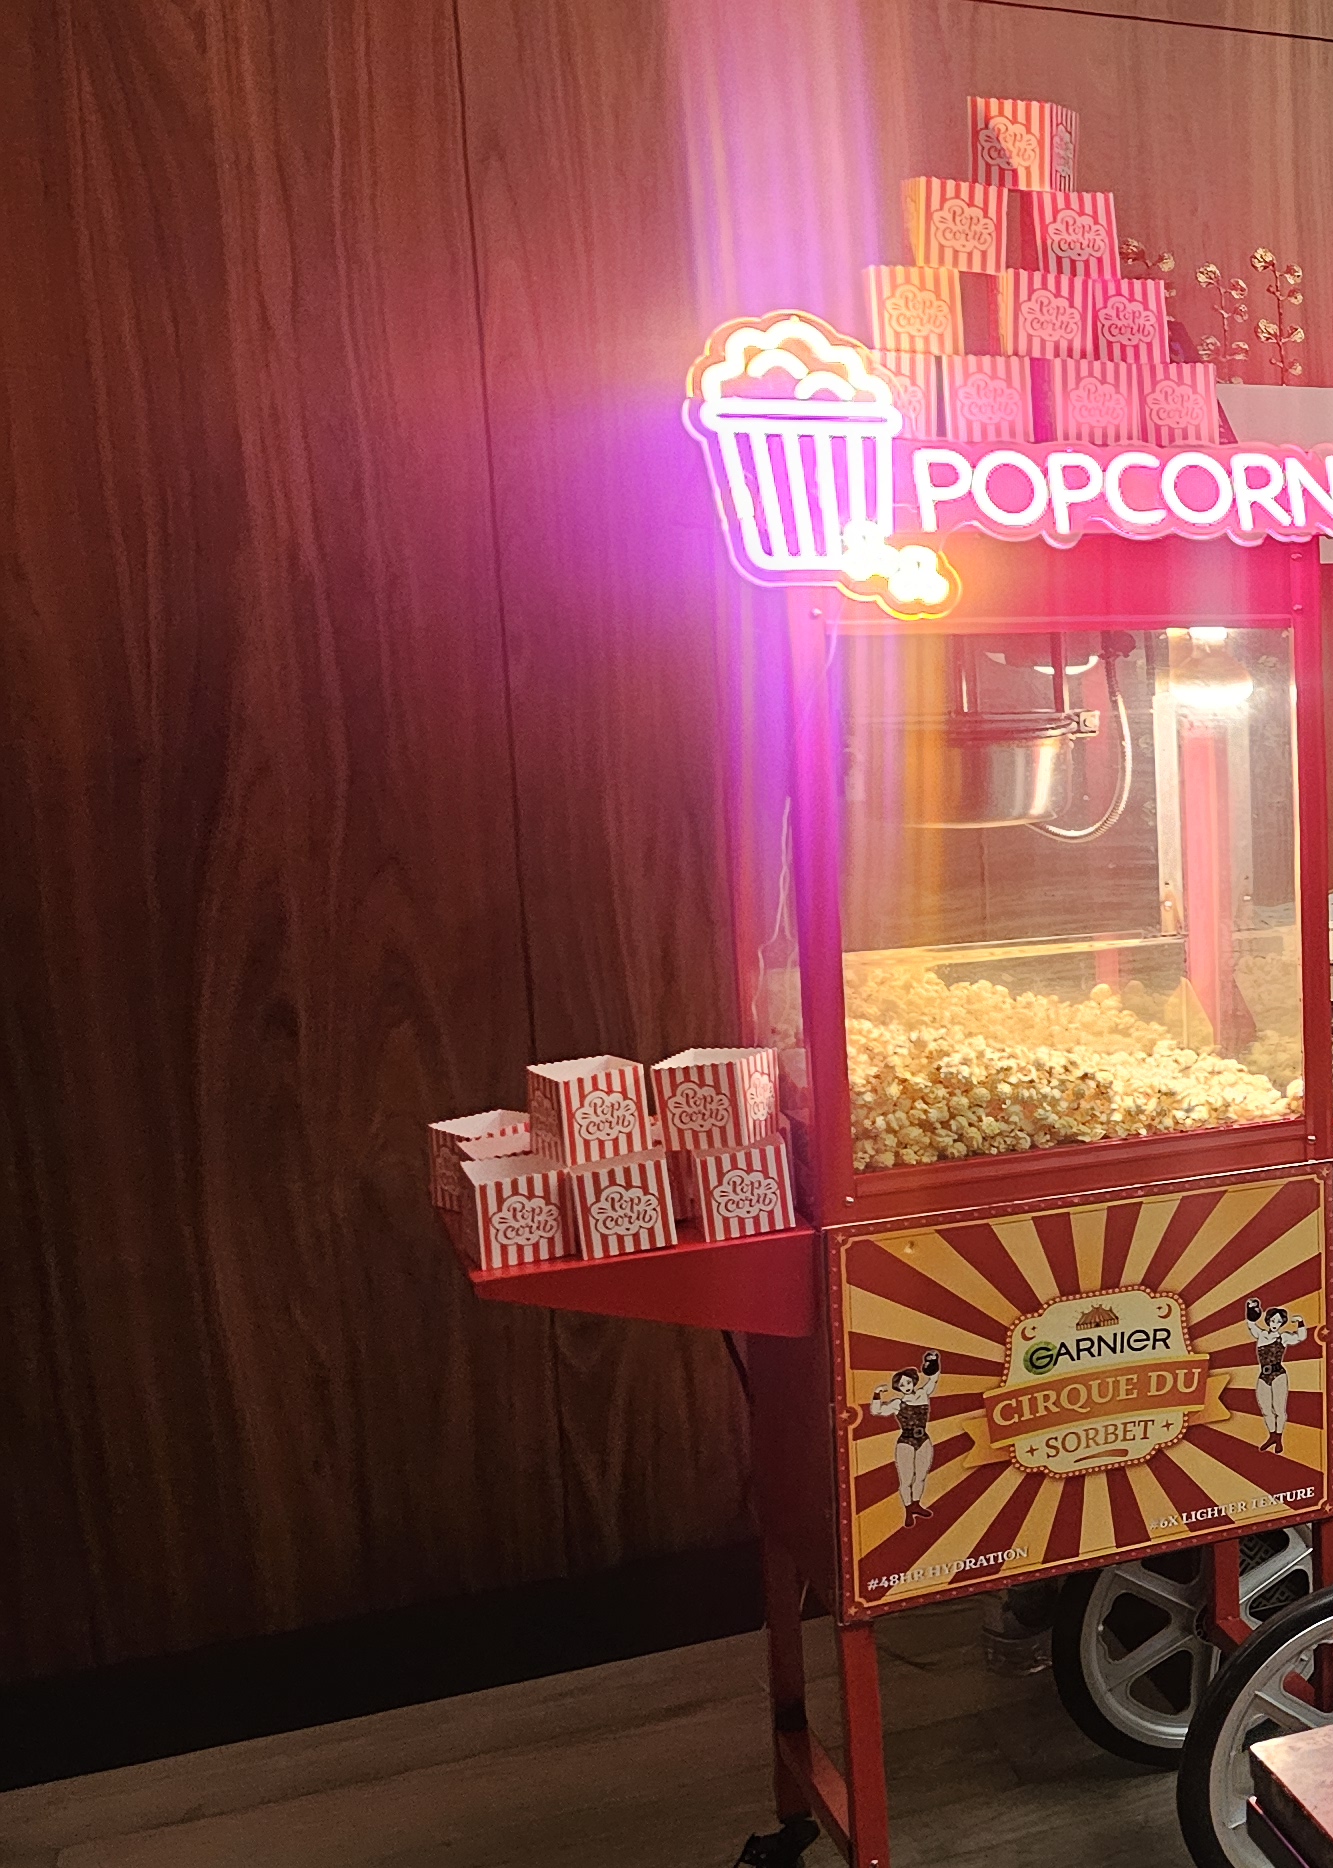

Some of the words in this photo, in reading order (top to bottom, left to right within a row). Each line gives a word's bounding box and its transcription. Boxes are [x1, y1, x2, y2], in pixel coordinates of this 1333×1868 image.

[589, 1096, 621, 1118] Pop
[680, 1088, 713, 1111] Pop
[728, 1175, 762, 1196] Pop
[507, 1201, 542, 1223] Pop
[605, 1191, 642, 1213] Pop
[992, 1374, 1138, 1426] CIRQUE
[1147, 1368, 1202, 1397] DU
[1044, 1419, 1155, 1459] SORBET
[1150, 1514, 1179, 1531] #6X
[1182, 1500, 1248, 1525] LIGHTER
[1251, 1486, 1315, 1510] TEXTURE
[866, 1567, 926, 1592] #48HR
[925, 1545, 1029, 1579] HYDRATION
